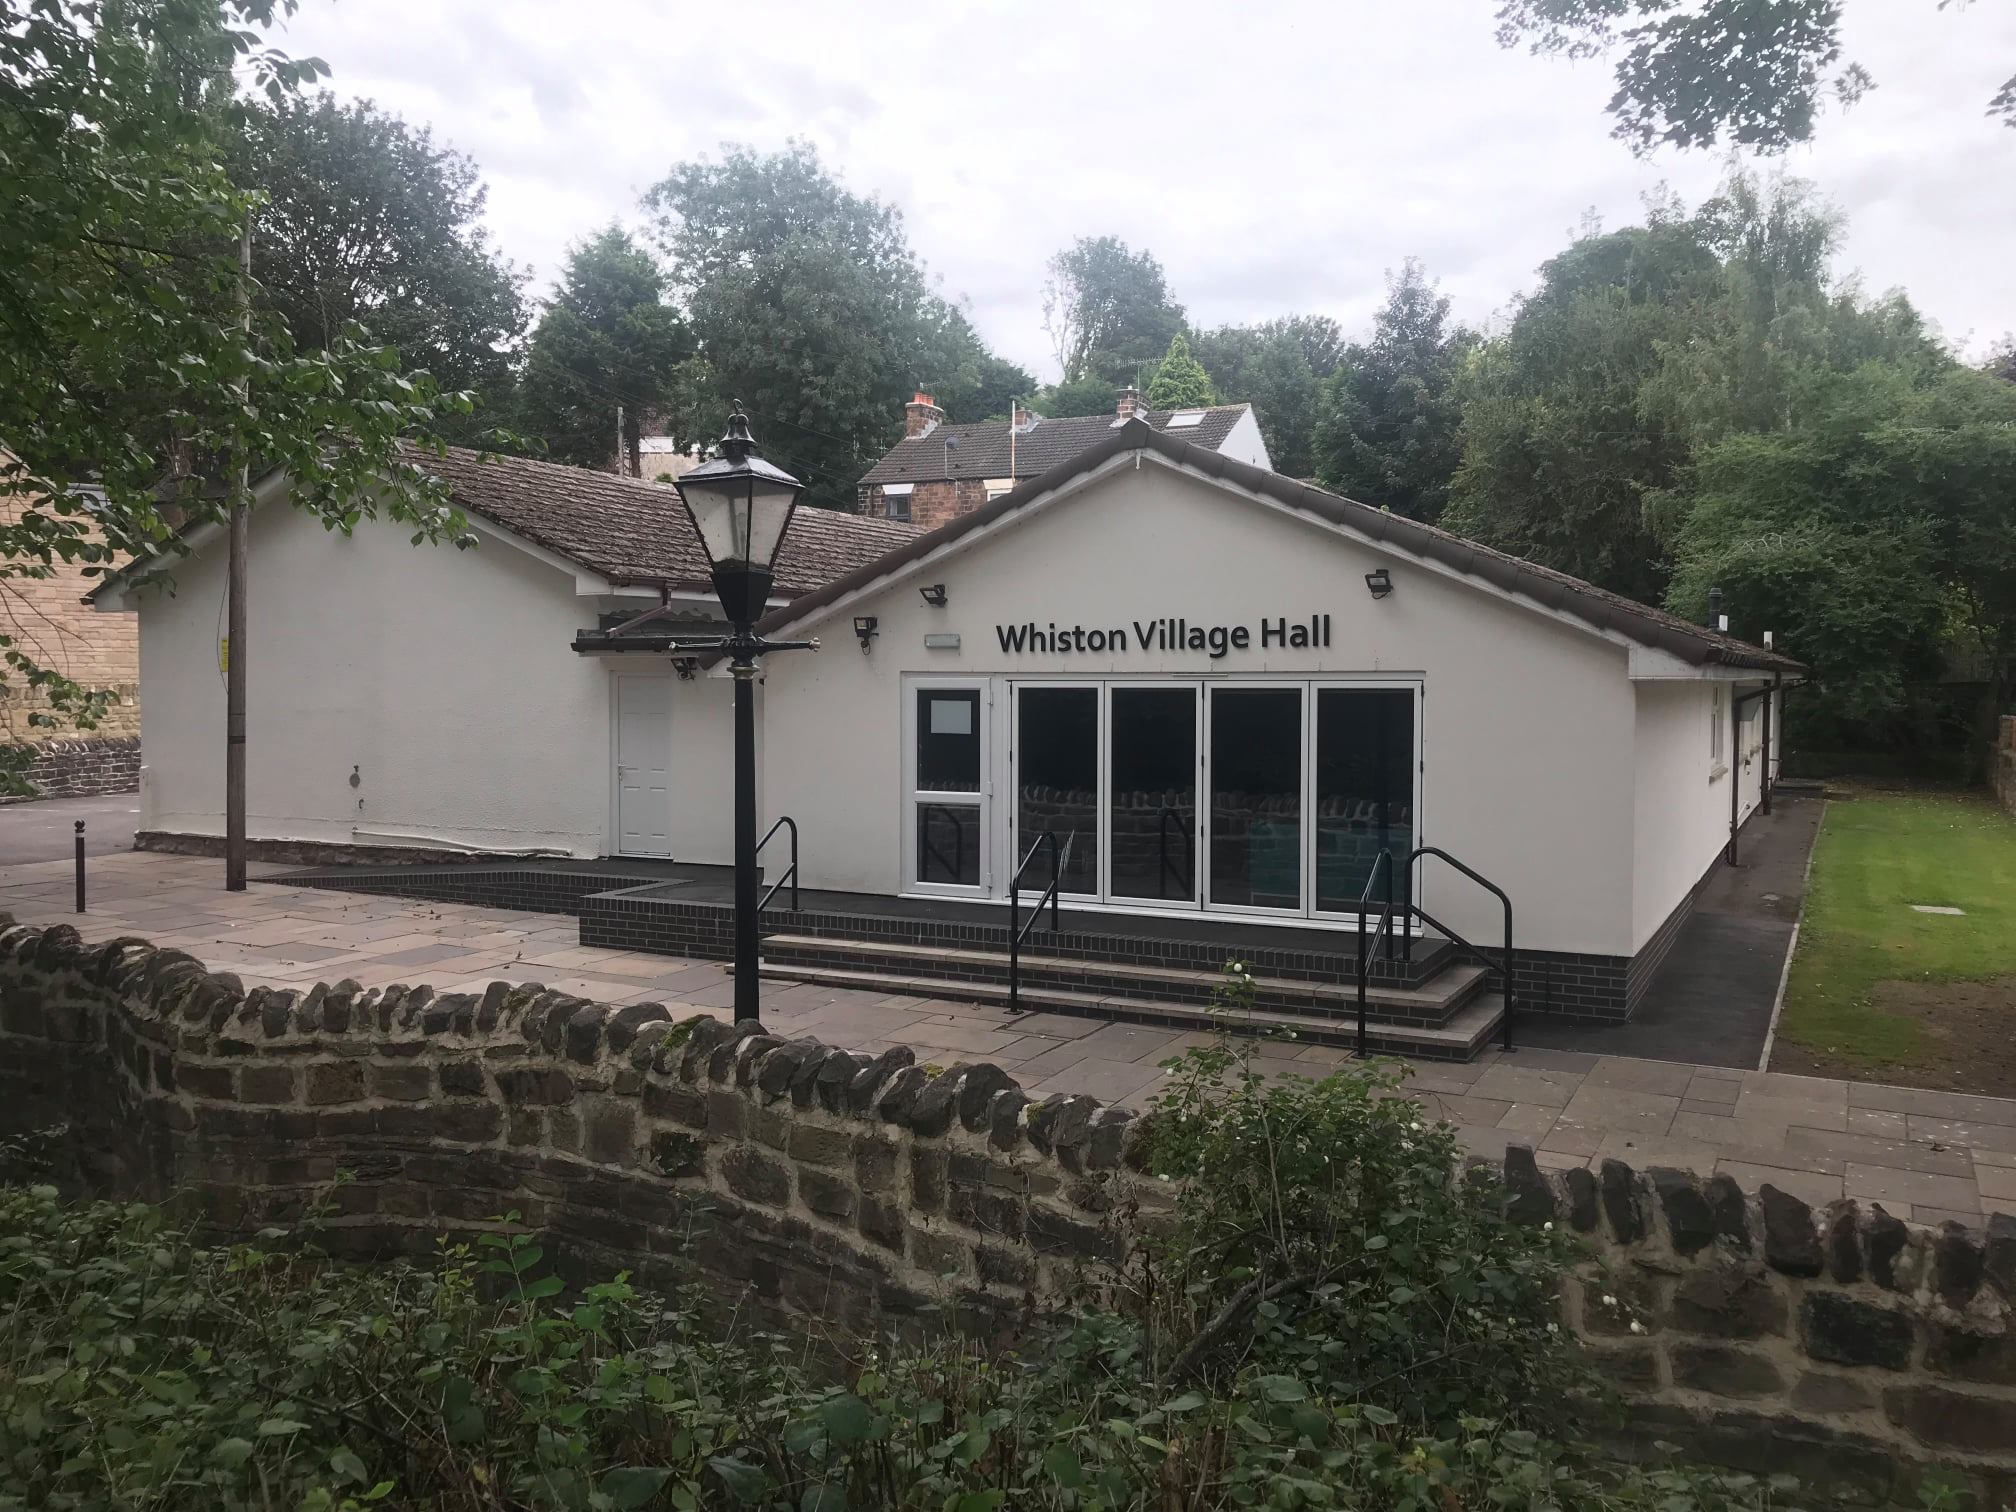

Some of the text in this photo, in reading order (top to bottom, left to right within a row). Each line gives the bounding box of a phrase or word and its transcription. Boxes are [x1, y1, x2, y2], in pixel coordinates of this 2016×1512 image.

[995, 614, 1331, 659] Whiston Village Hall
